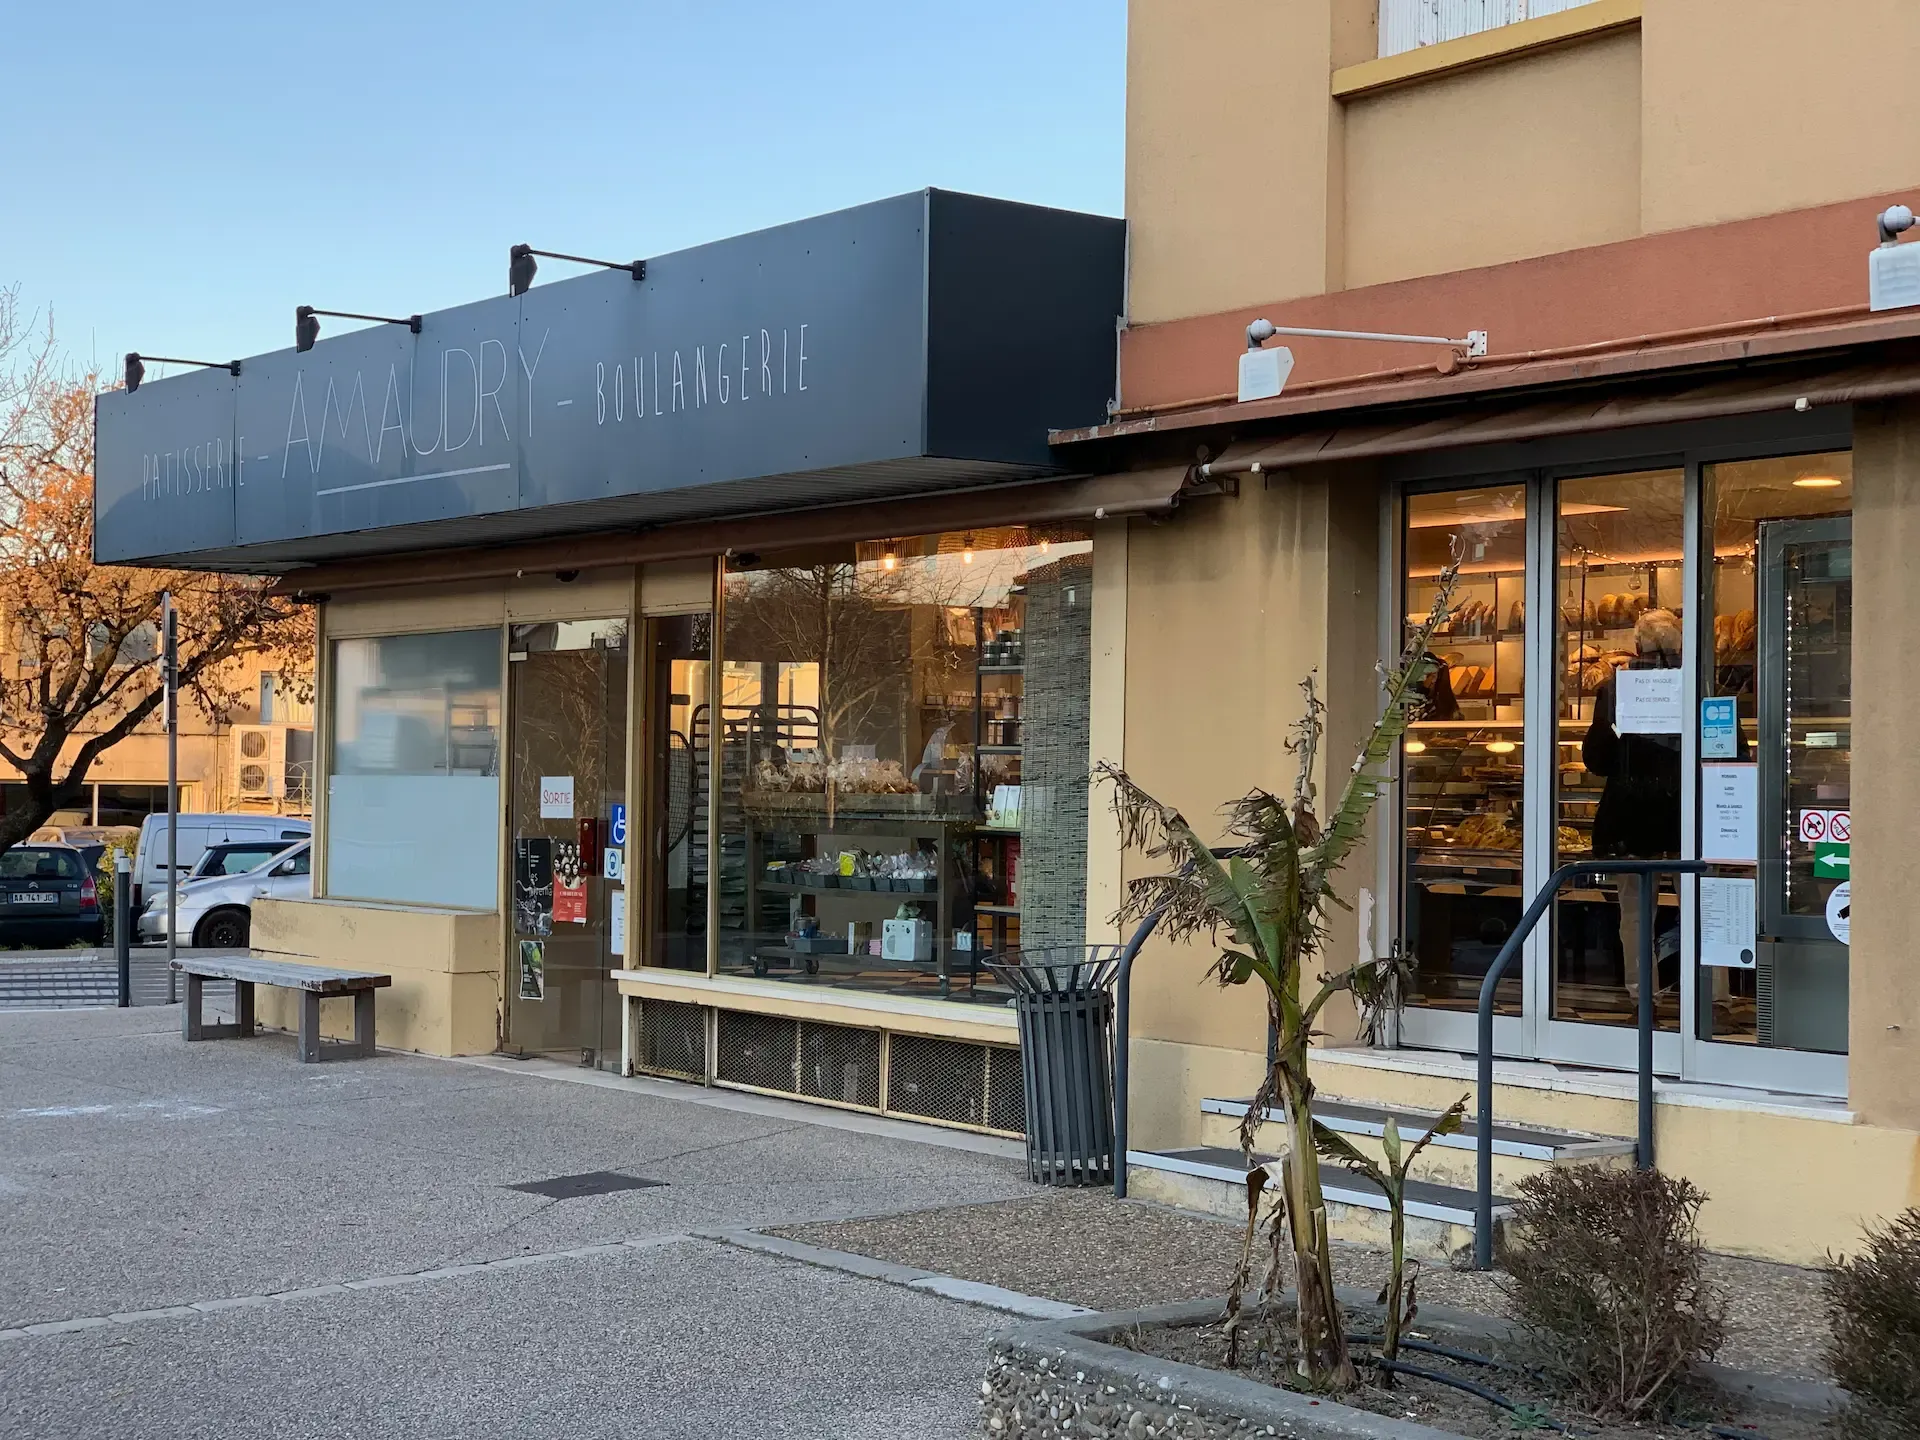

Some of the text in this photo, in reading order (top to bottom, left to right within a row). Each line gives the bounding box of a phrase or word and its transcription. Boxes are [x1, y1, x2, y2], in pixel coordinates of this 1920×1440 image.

[143, 436, 245, 501] PATISSERIE
[282, 328, 550, 479] AMAUDRY
[596, 324, 809, 425] BOULANGERIE
[543, 789, 571, 804] SORTIE
